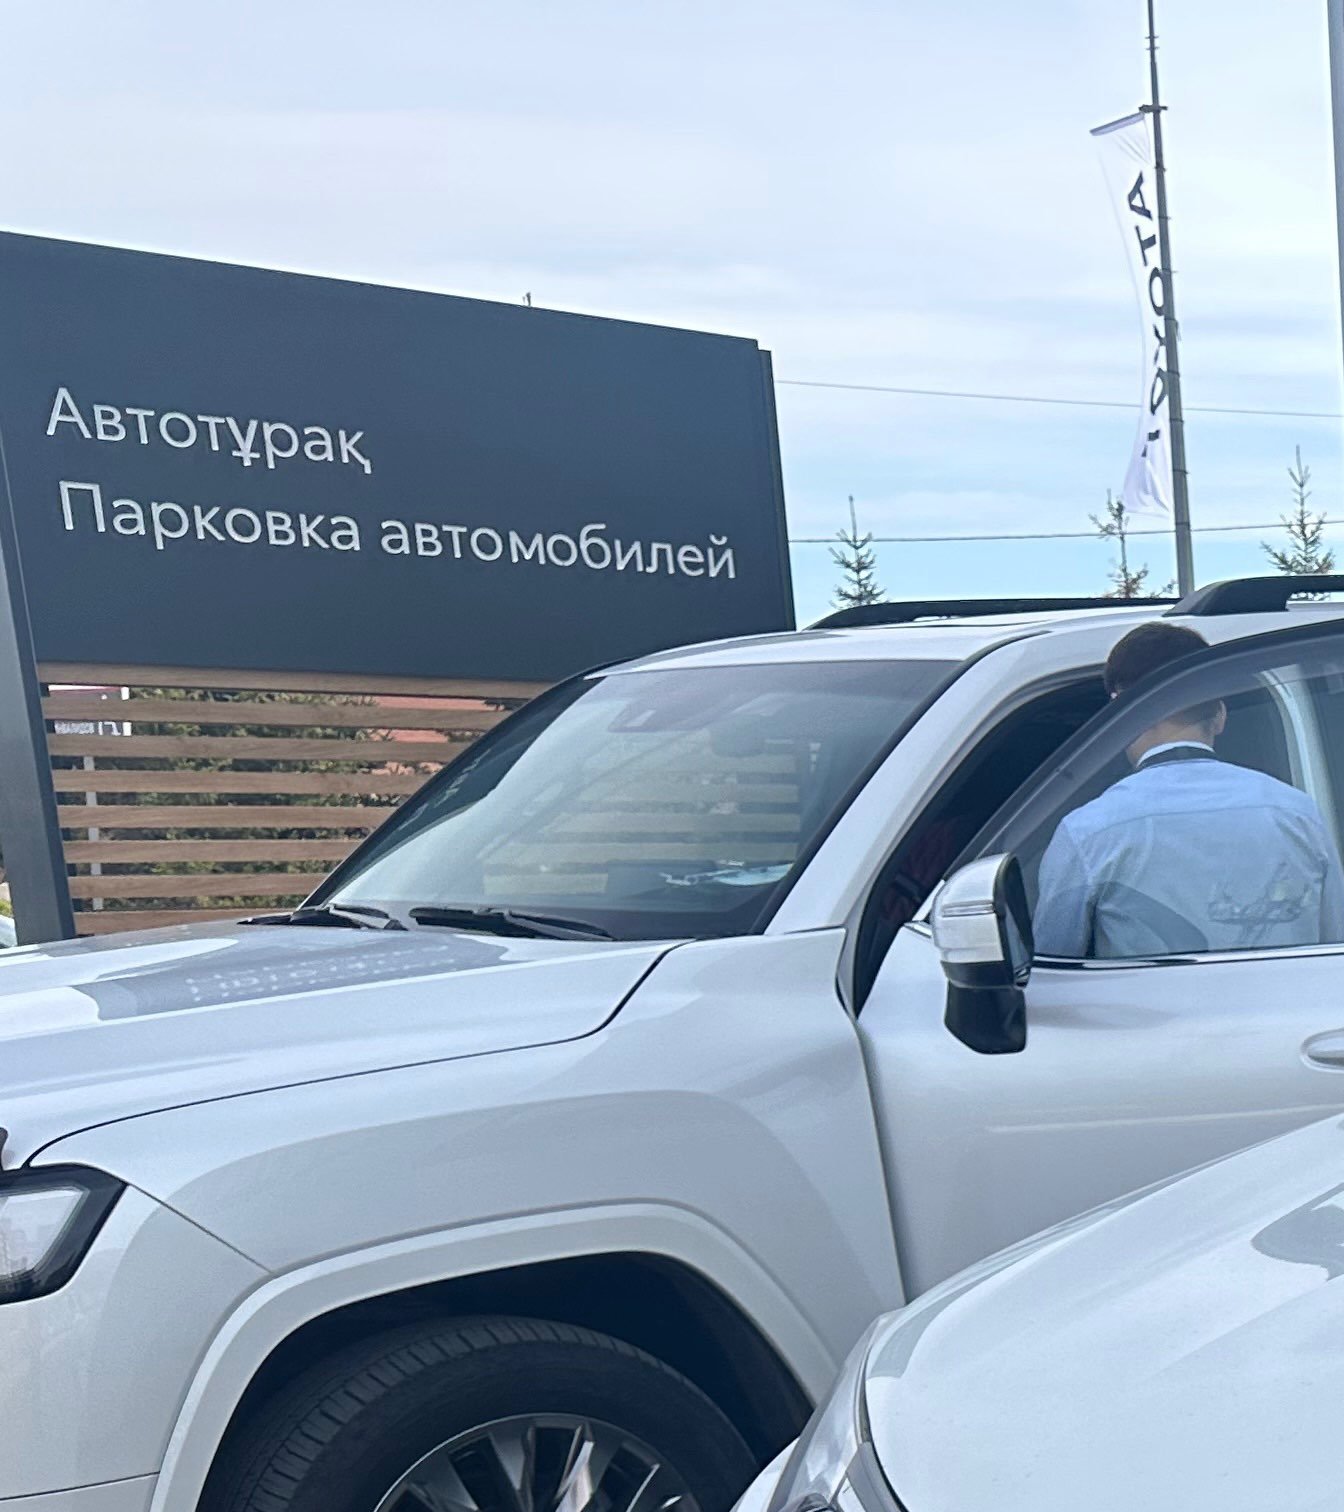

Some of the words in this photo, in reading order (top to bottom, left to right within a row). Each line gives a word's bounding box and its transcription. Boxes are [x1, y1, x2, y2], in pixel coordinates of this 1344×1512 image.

[47, 387, 372, 474] Автотұрақ
[58, 480, 362, 553] Парковка
[380, 519, 738, 580] автомобилей
